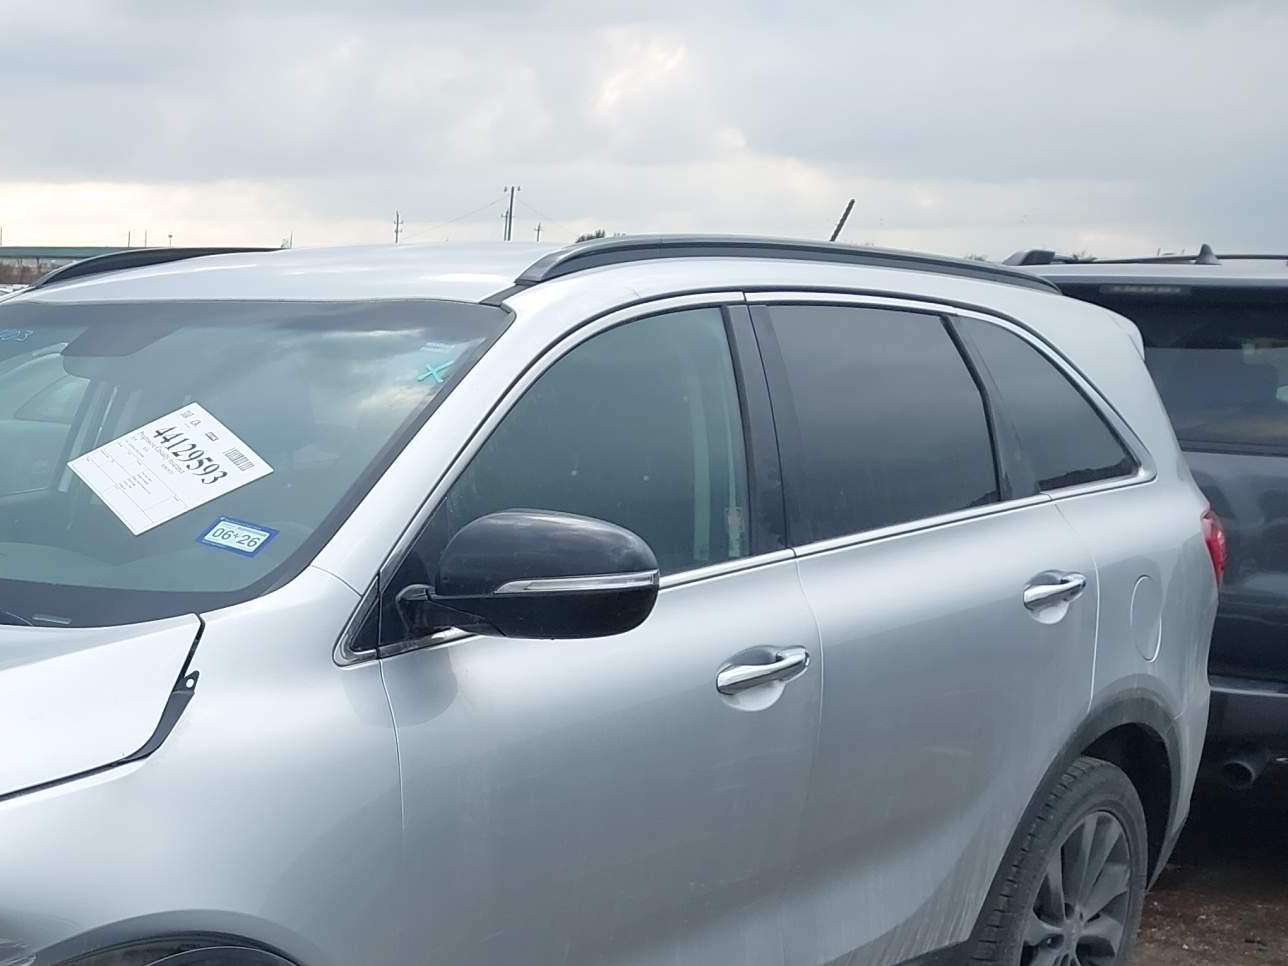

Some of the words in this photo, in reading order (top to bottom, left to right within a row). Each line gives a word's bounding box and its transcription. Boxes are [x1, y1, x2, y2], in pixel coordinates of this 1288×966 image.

[153, 426, 228, 485] 44129593
[212, 527, 234, 540] 06
[236, 534, 261, 548] 26
